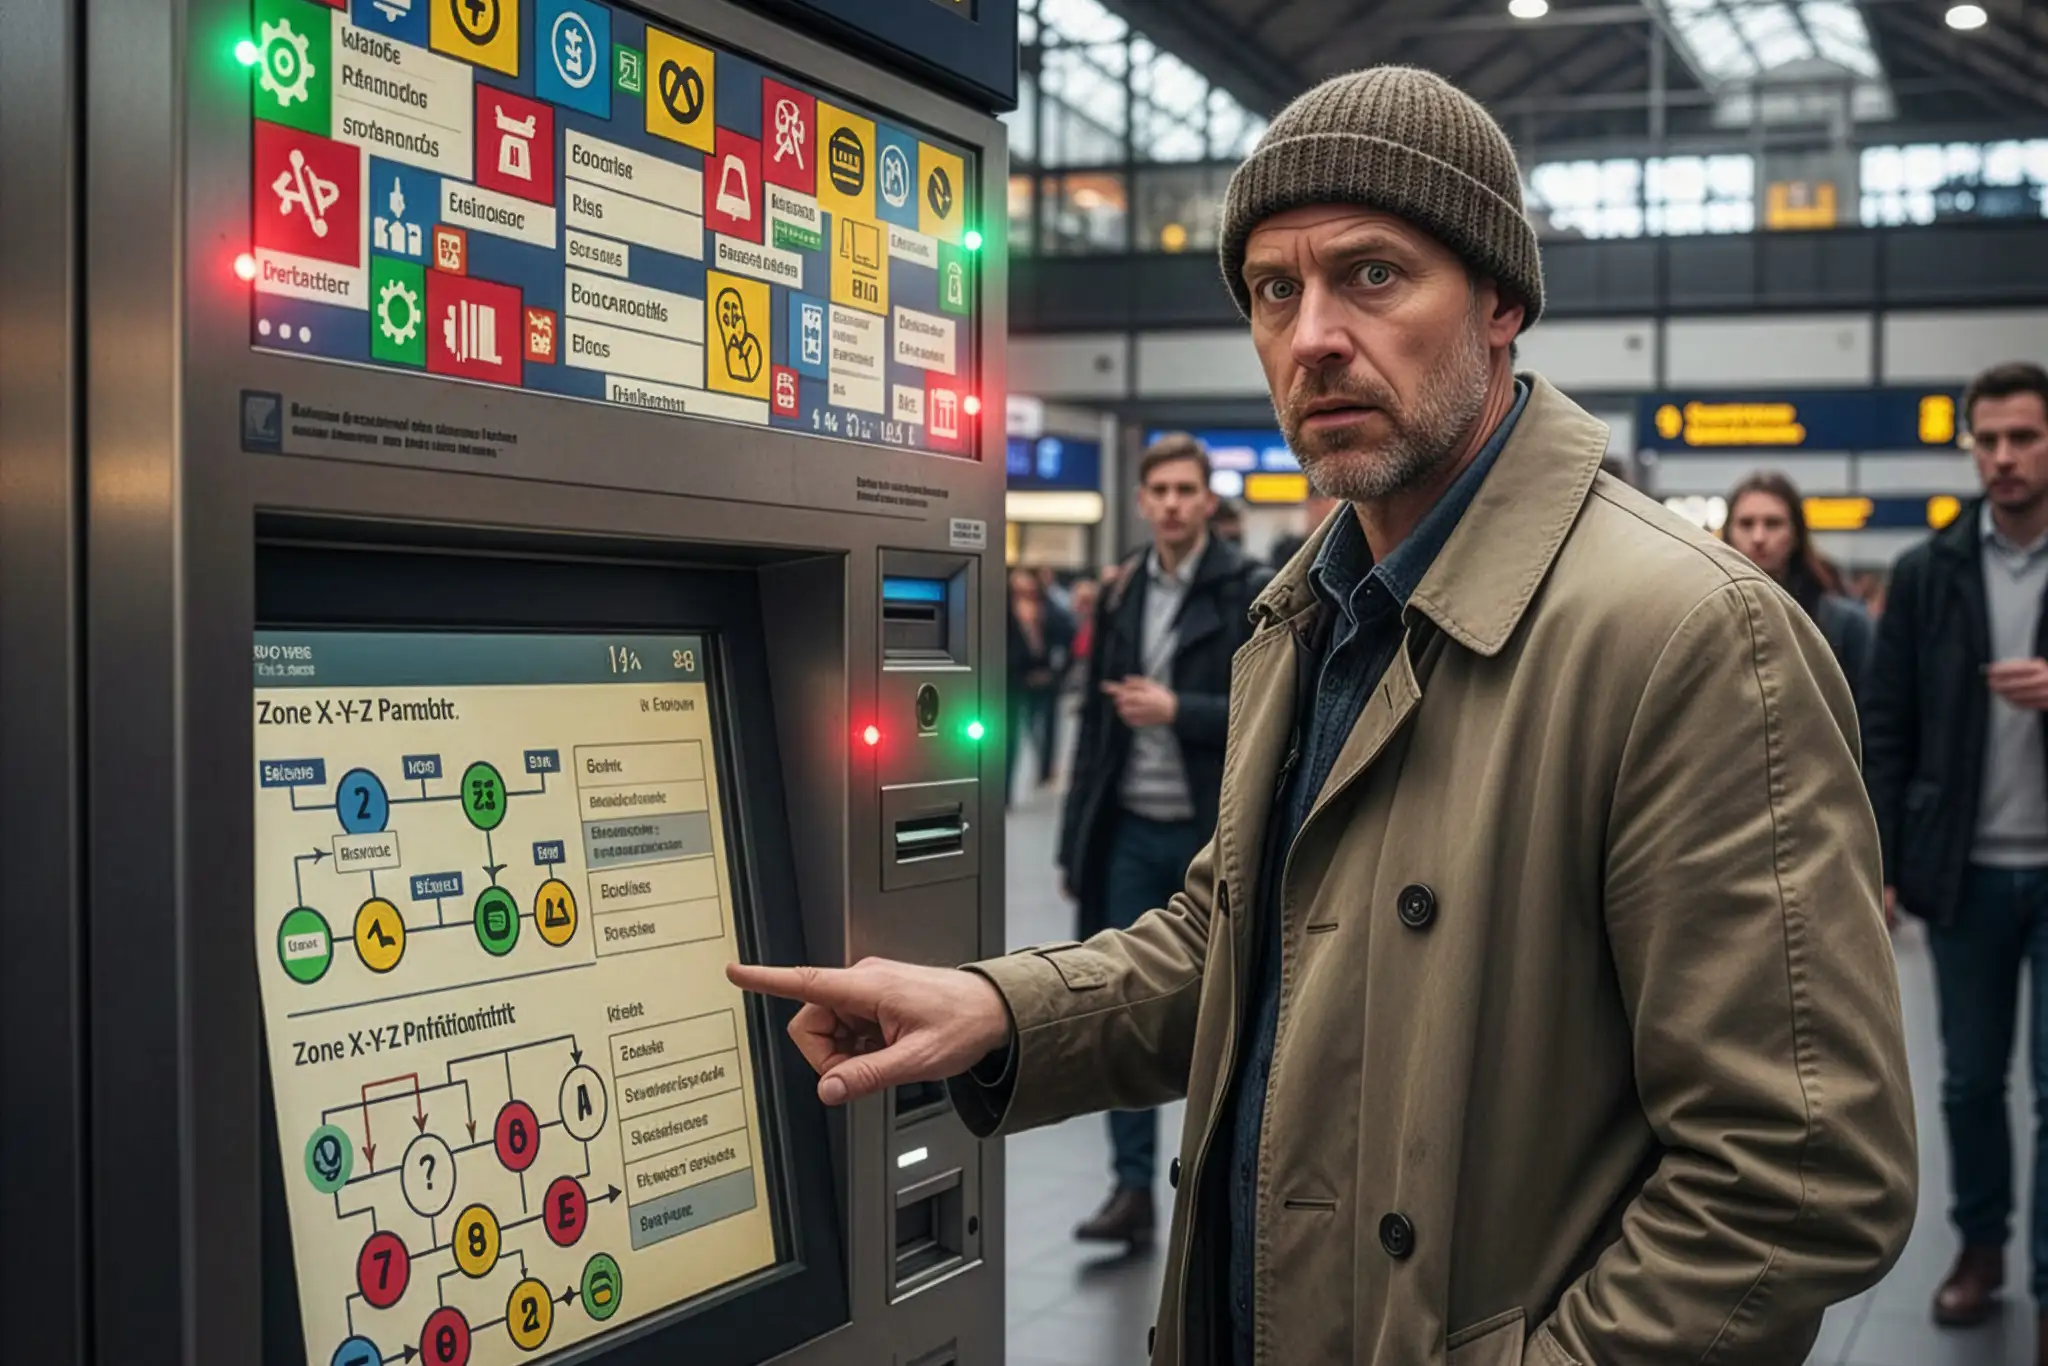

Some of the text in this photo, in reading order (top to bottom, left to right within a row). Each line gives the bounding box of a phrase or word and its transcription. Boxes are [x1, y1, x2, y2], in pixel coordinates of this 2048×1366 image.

[256, 700, 312, 725] Zone
[354, 786, 371, 820] 2
[292, 1039, 345, 1066] Zone
[419, 1153, 437, 1191] ?
[373, 1250, 392, 1290] 7
[521, 1296, 540, 1334] 2
